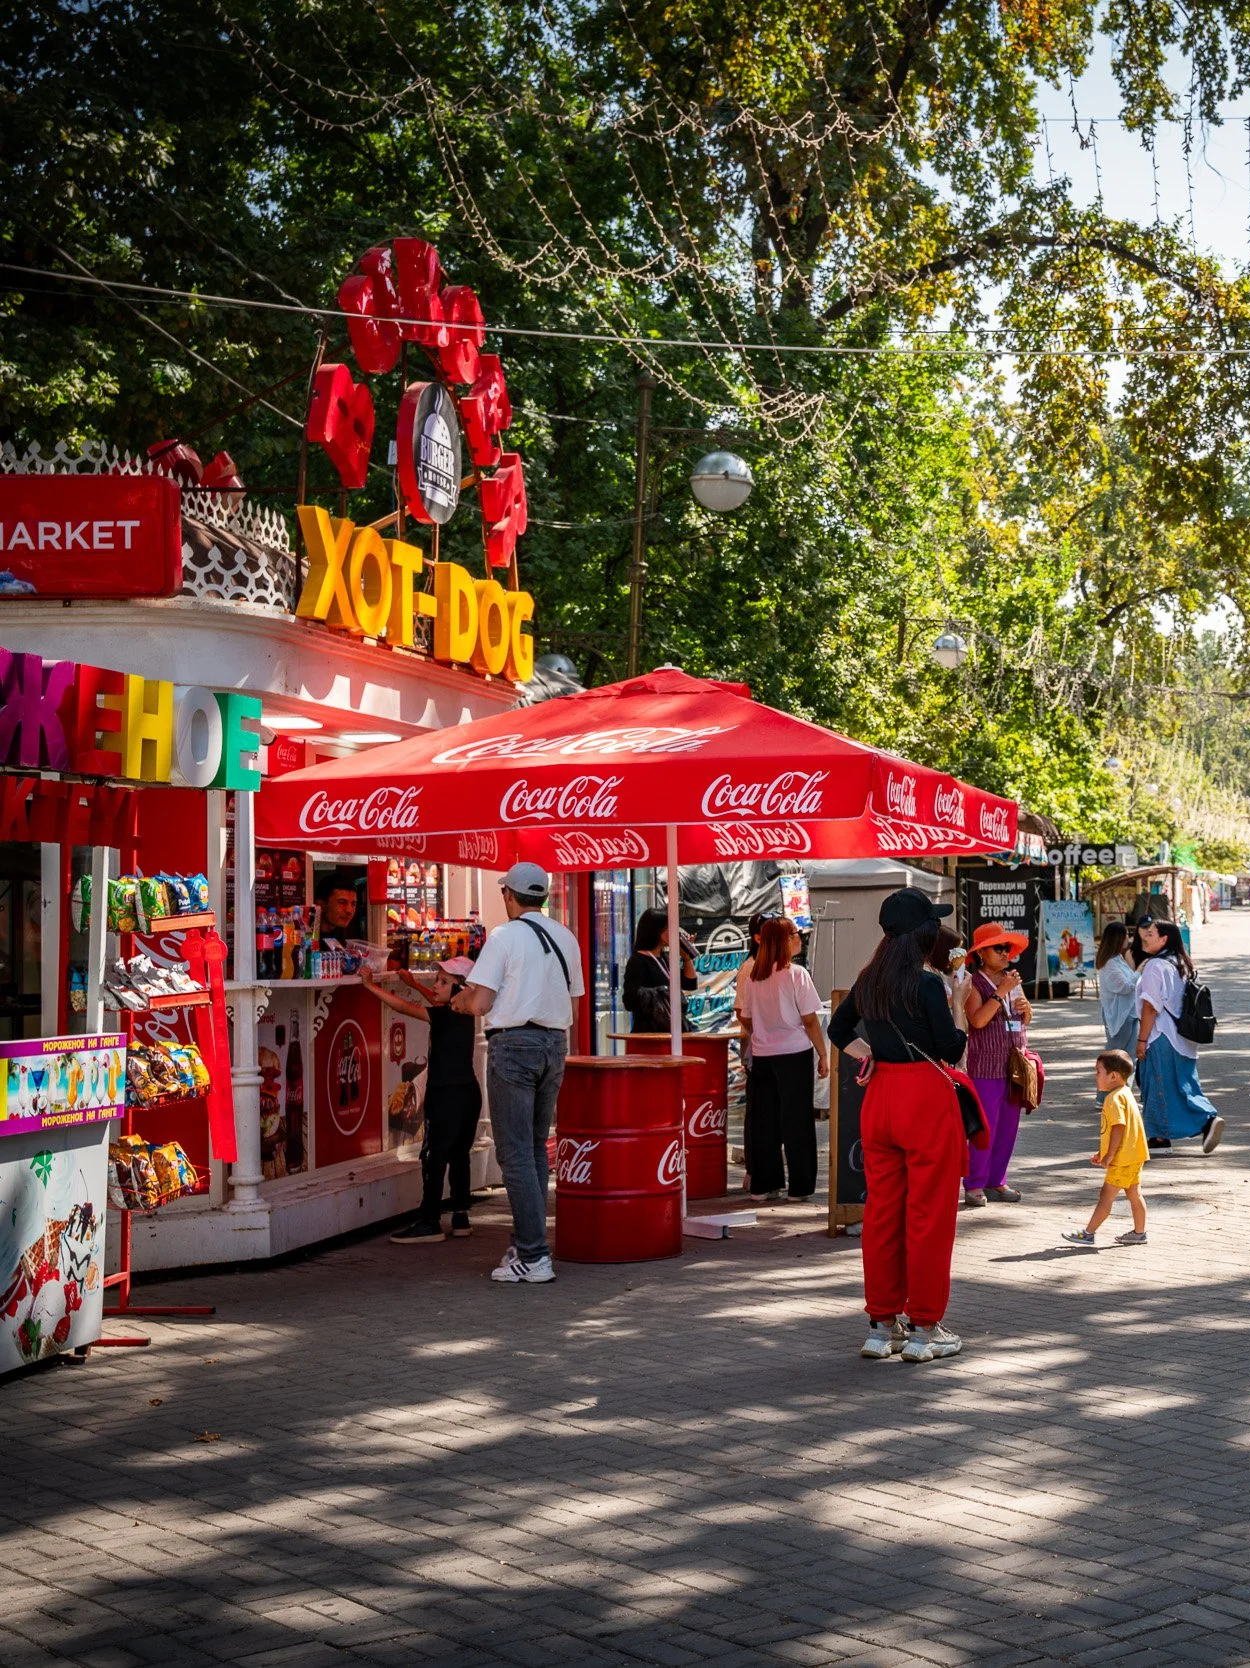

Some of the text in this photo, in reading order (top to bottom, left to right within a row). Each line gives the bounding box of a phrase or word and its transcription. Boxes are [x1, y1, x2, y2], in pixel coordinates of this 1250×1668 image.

[420, 434, 455, 477] BURGER
[0, 520, 140, 550] ARKET
[432, 725, 741, 764] Coca-Cola
[299, 786, 424, 833] Coca-Cola
[500, 776, 624, 823] Coca-Cola
[701, 769, 830, 817] Coca-Cola
[886, 771, 917, 817] Coca-Cola
[933, 783, 965, 831] Coca-Cola
[979, 801, 1010, 844] Coca-Cola
[1030, 844, 1114, 866] offee
[979, 882, 1016, 891] Переходи
[981, 894, 1025, 906] ТЕМНУЮ
[980, 906, 1026, 918] СТОРОНУ
[42, 1038, 85, 1052] МОРОЖЕНОЕ
[88, 1038, 97, 1049] НА
[41, 1111, 84, 1127] МОРОЖЕНОЕ
[86, 1110, 96, 1121] НА
